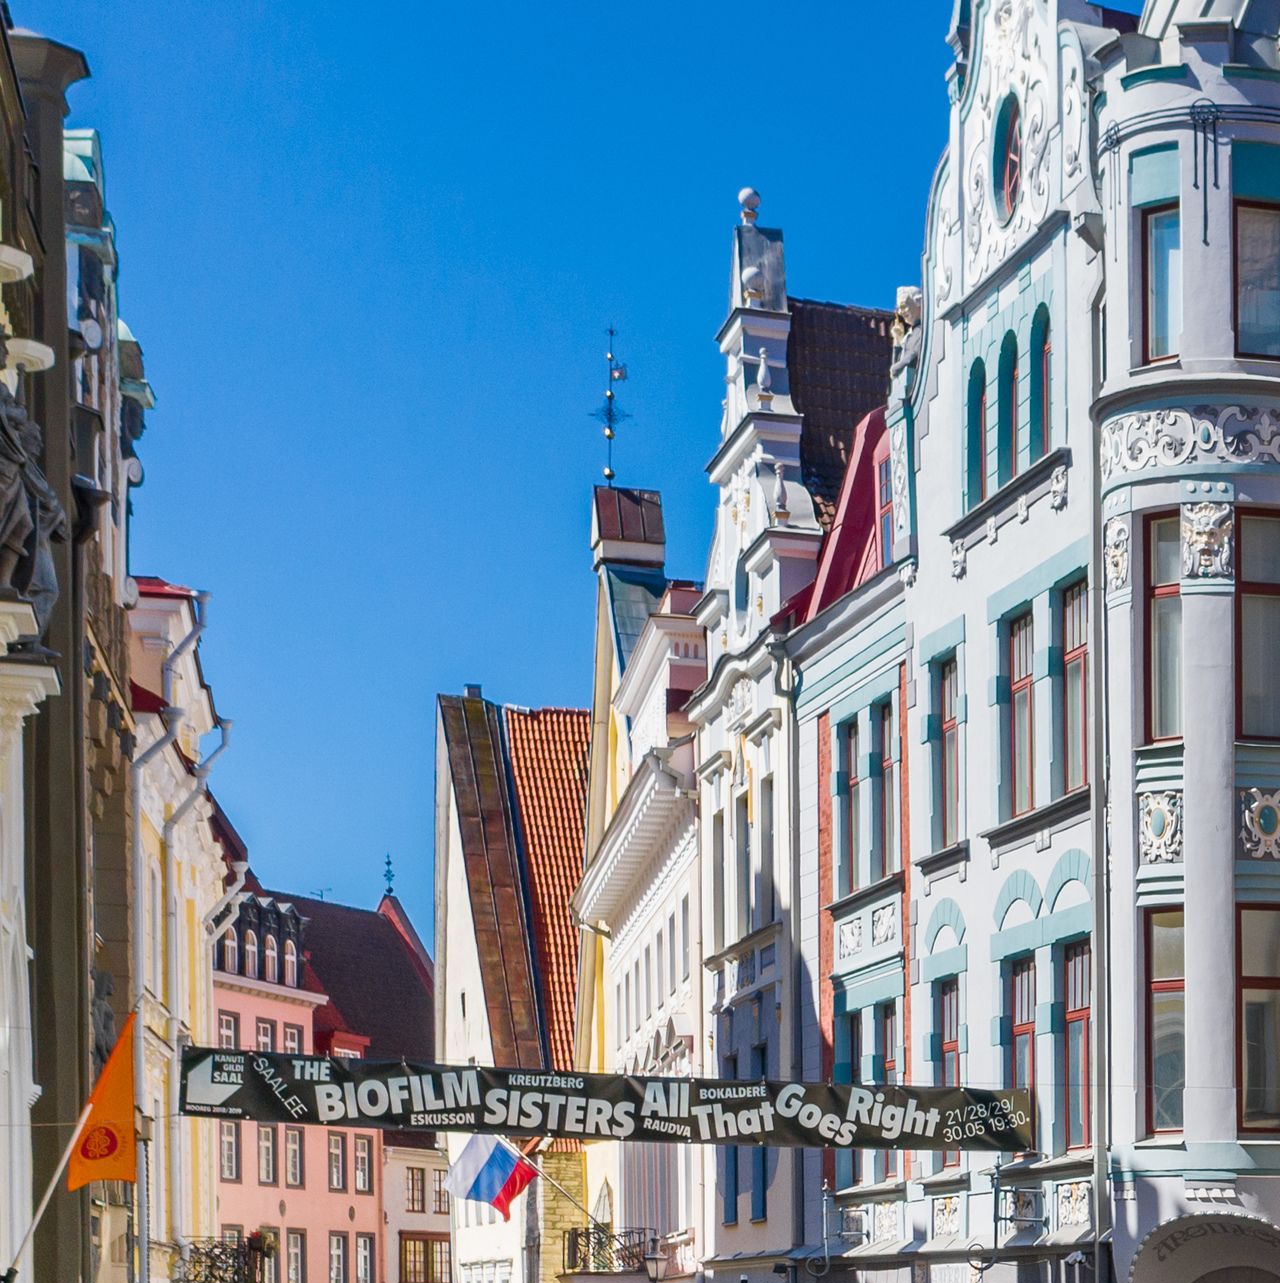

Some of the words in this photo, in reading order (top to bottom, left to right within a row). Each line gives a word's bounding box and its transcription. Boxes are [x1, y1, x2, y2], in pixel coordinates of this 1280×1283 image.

[214, 1054, 245, 1063] KANUTI
[223, 1063, 244, 1072] GILDI
[213, 1072, 243, 1083] SAAL
[292, 1059, 330, 1081] THE
[253, 1057, 308, 1119] SAAL.EE
[508, 1074, 584, 1089] KREUTZBERG
[699, 1086, 767, 1100] BOKALDERE
[315, 1069, 481, 1122] BIOFILM
[483, 1088, 635, 1138] SISTERS
[640, 1081, 690, 1118] All
[691, 1101, 775, 1141] That
[775, 1083, 857, 1146] Goes
[846, 1086, 940, 1140] Right
[945, 1096, 1015, 1126] 21/28/29/
[410, 1112, 475, 1126] ESKUSSON
[643, 1118, 692, 1138] RAUDVA
[943, 1120, 986, 1142] 30.05
